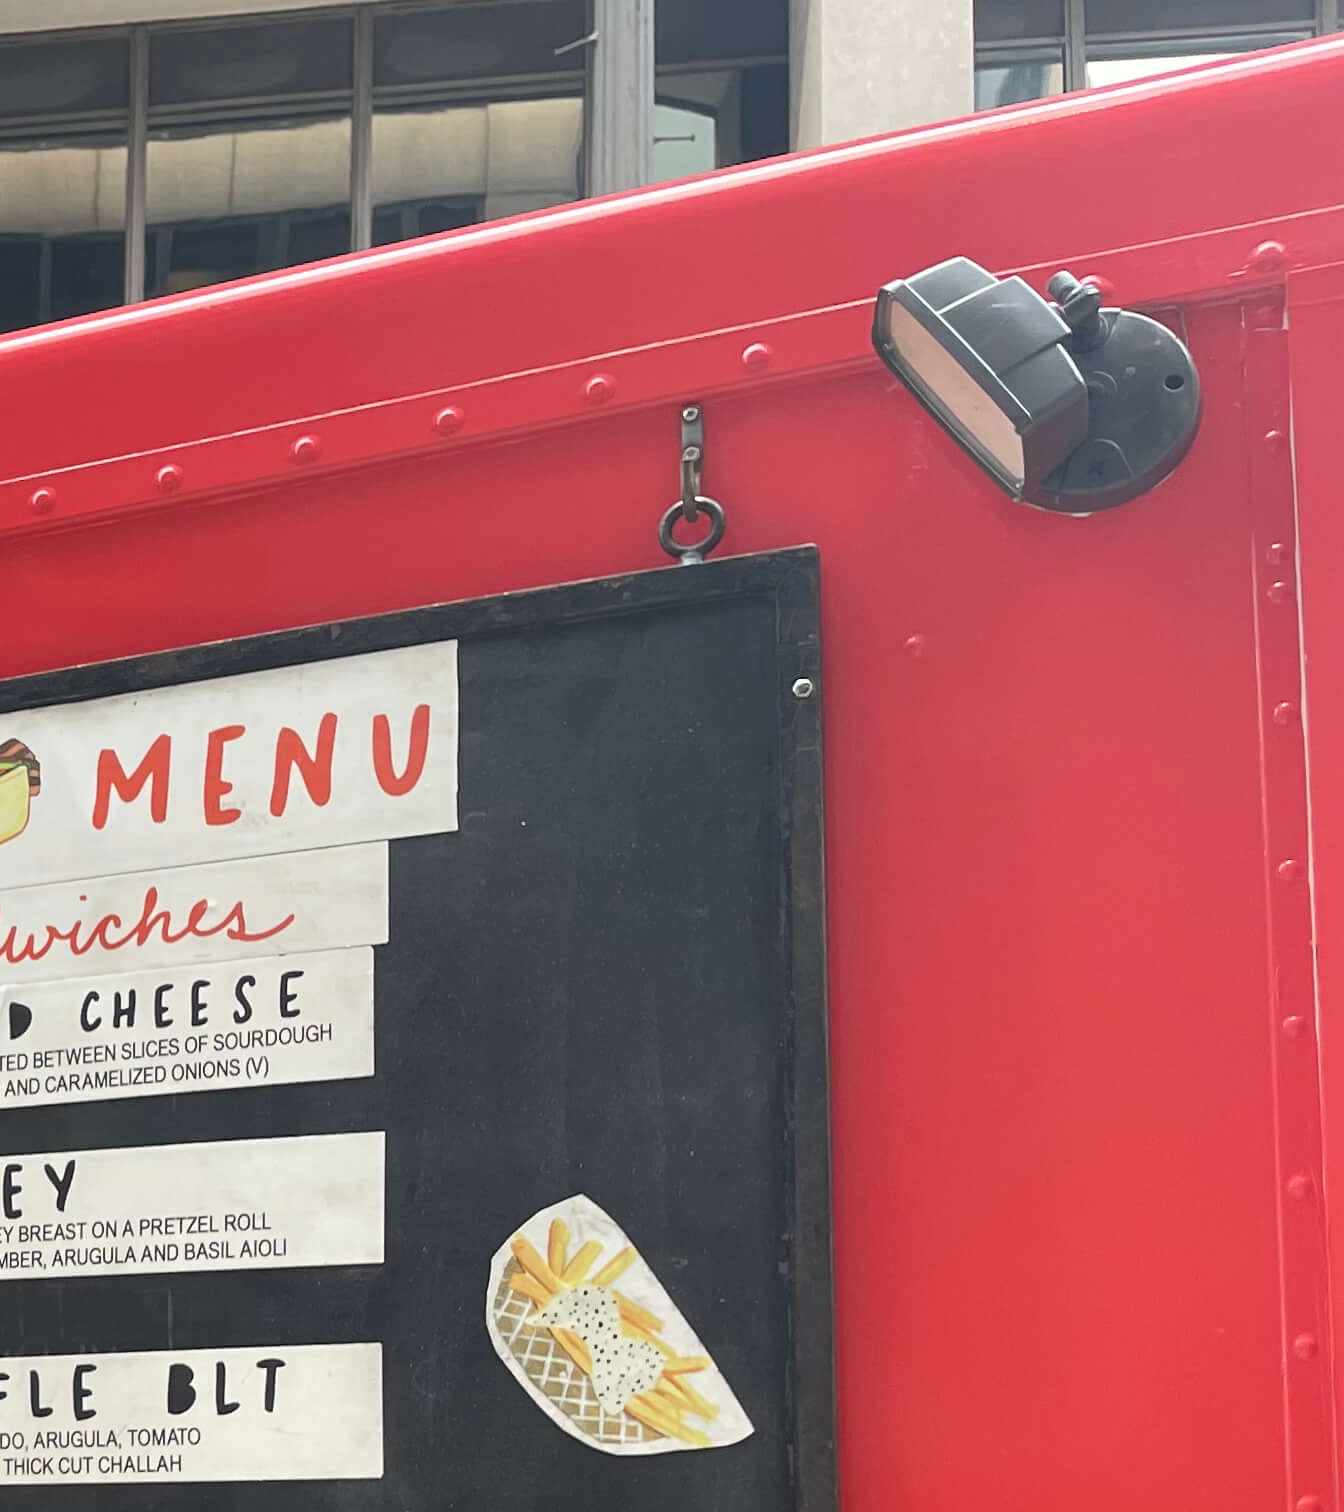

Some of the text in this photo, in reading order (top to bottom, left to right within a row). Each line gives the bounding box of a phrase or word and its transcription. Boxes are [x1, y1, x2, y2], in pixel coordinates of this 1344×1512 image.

[92, 704, 432, 830] MENU
[80, 970, 305, 1033] CHEESE
[33, 1042, 116, 1069] BETWEEN
[121, 1036, 180, 1060] SLICES
[184, 1033, 208, 1054] OF
[213, 1021, 332, 1051] SOURDOUGH
[4, 1076, 40, 1097] AND
[44, 1063, 167, 1093] CARAMELIZED
[171, 1057, 241, 1081] ONIONS
[246, 1054, 269, 1078] (V)
[18, 1220, 87, 1243] BREAST
[91, 1219, 117, 1239] ON
[122, 1217, 134, 1237] A
[139, 1213, 219, 1236] PRETZEL
[224, 1211, 271, 1232] ROLL
[51, 1244, 137, 1267] ARUGULA
[140, 1242, 179, 1262] AND
[184, 1239, 235, 1260] BASIL
[239, 1237, 287, 1258] AIOLI
[167, 1359, 286, 1416] BLT
[33, 1428, 124, 1453] ARUGULA,
[127, 1425, 201, 1447] TOMATO
[3, 1455, 54, 1475] THICK
[58, 1454, 93, 1474] CUT
[98, 1453, 182, 1474] CHALLAH
